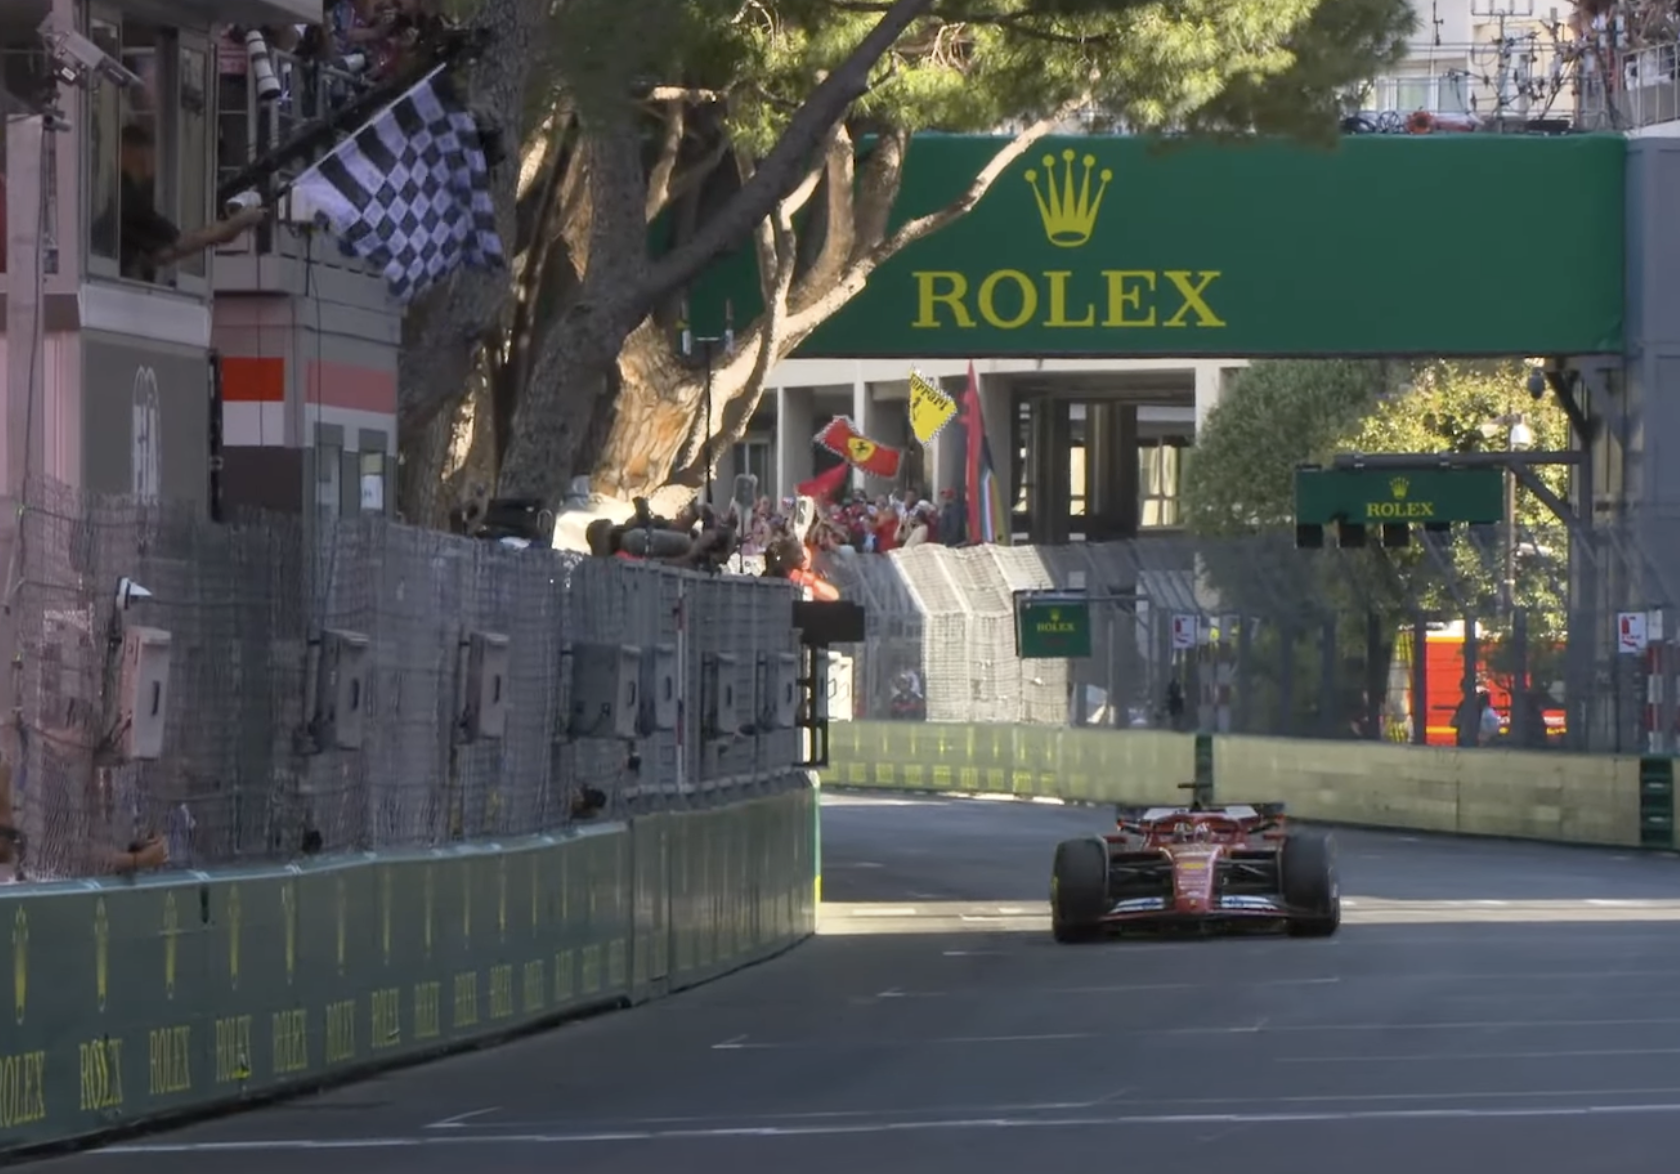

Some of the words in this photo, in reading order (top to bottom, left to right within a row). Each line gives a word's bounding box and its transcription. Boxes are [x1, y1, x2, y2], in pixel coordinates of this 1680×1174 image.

[911, 269, 1227, 330] ROLEX
[1366, 502, 1434, 517] ROLEX
[1036, 622, 1076, 632] ROLEX
[0, 1050, 46, 1128] OLEX
